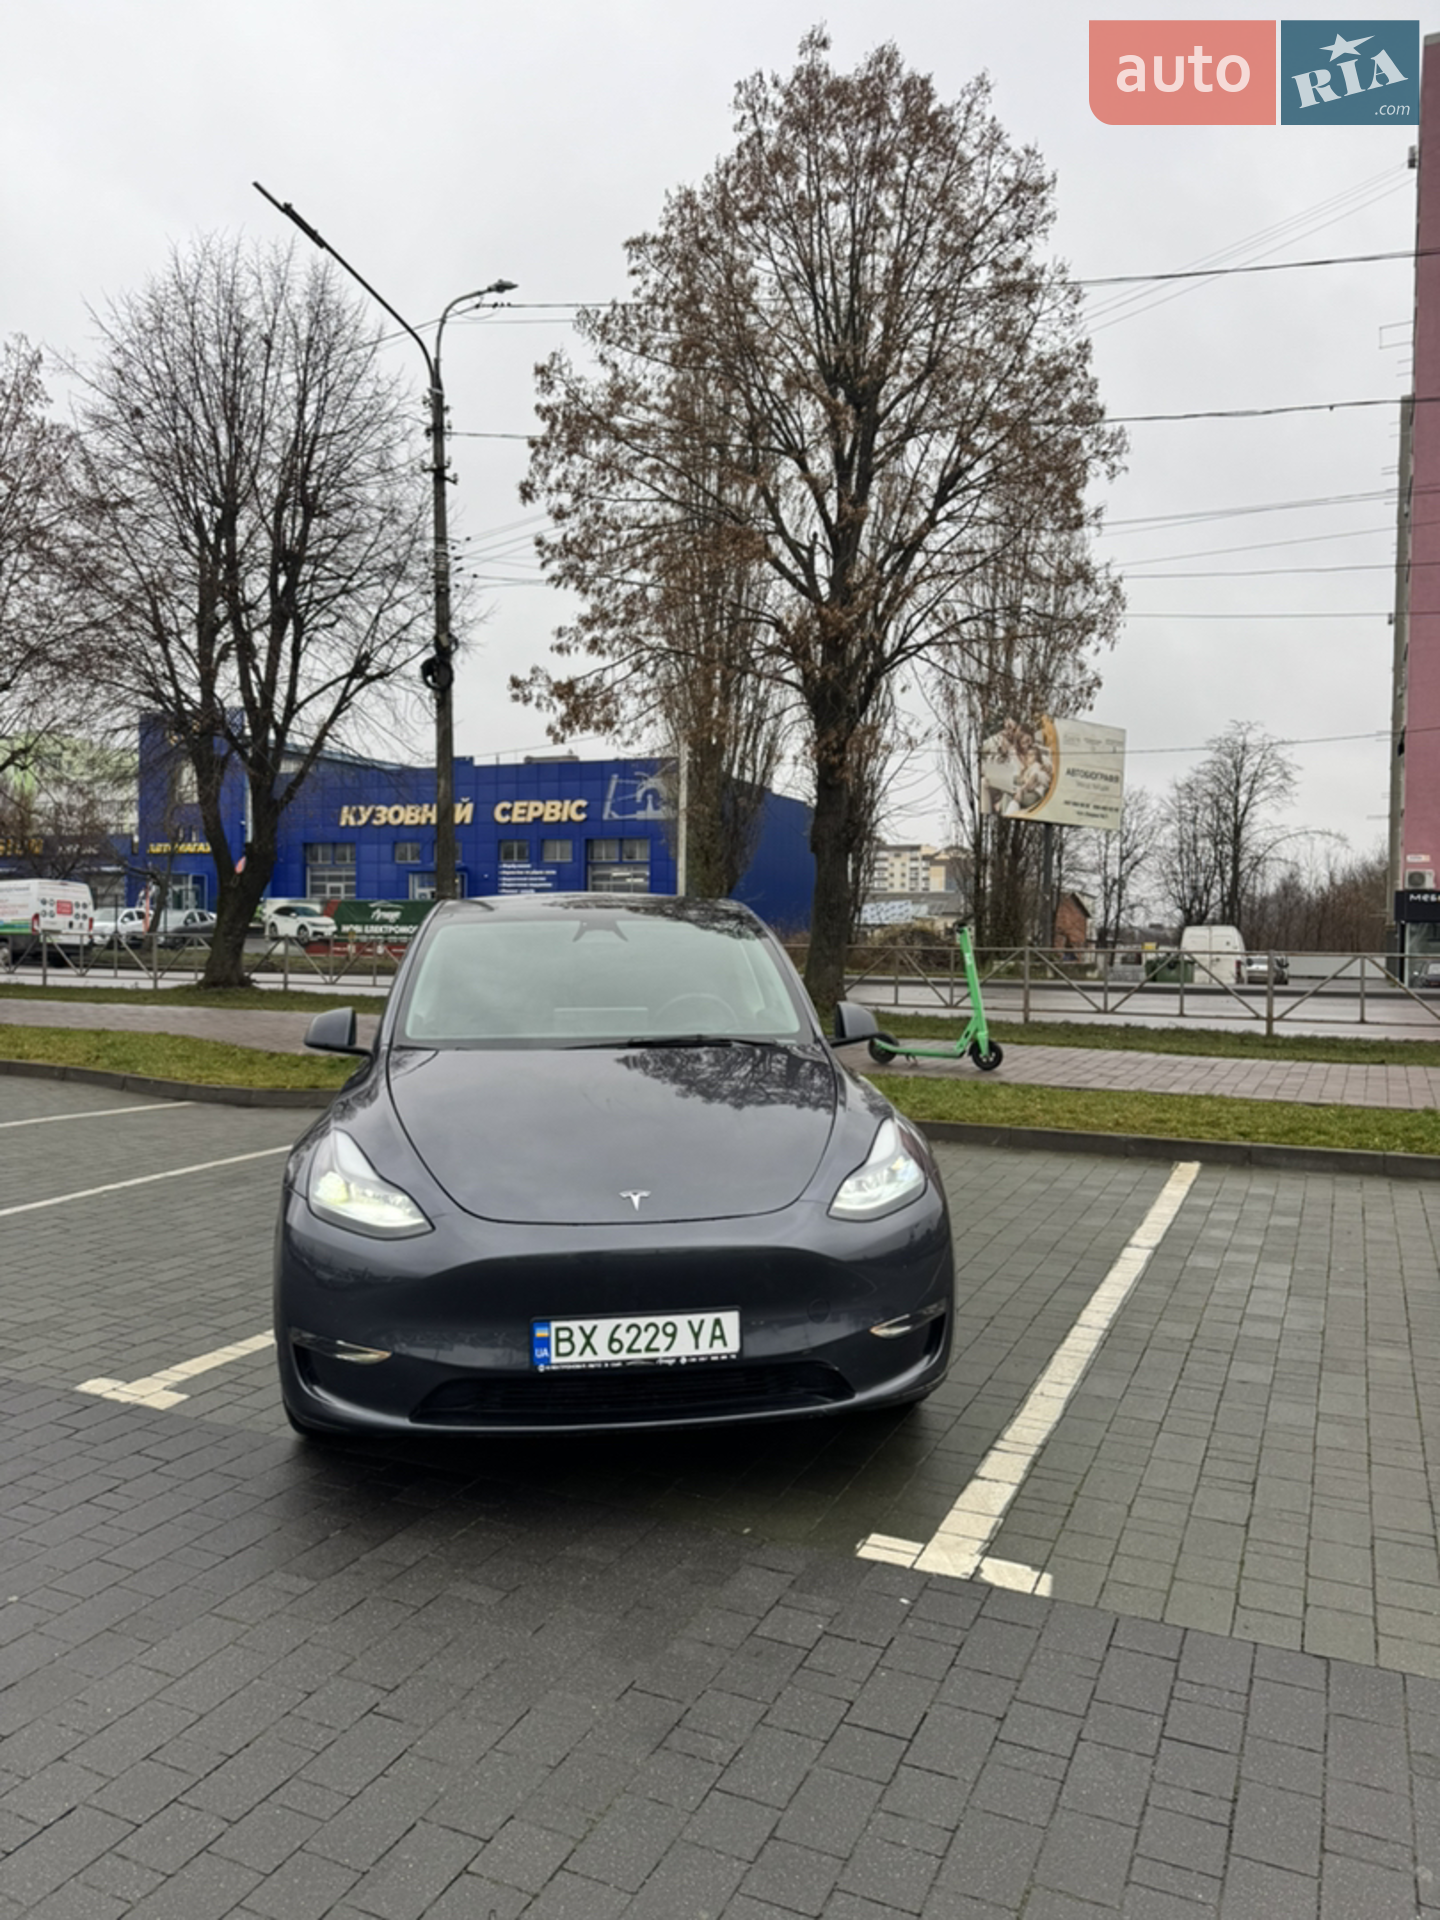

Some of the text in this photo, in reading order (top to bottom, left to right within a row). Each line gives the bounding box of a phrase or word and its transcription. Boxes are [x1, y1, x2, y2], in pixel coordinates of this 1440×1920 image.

[340, 797, 588, 827] КУЗОВНЙ СЕРВІС
[554, 1317, 728, 1358] BX 6229 YA
[534, 1347, 549, 1359] UA
